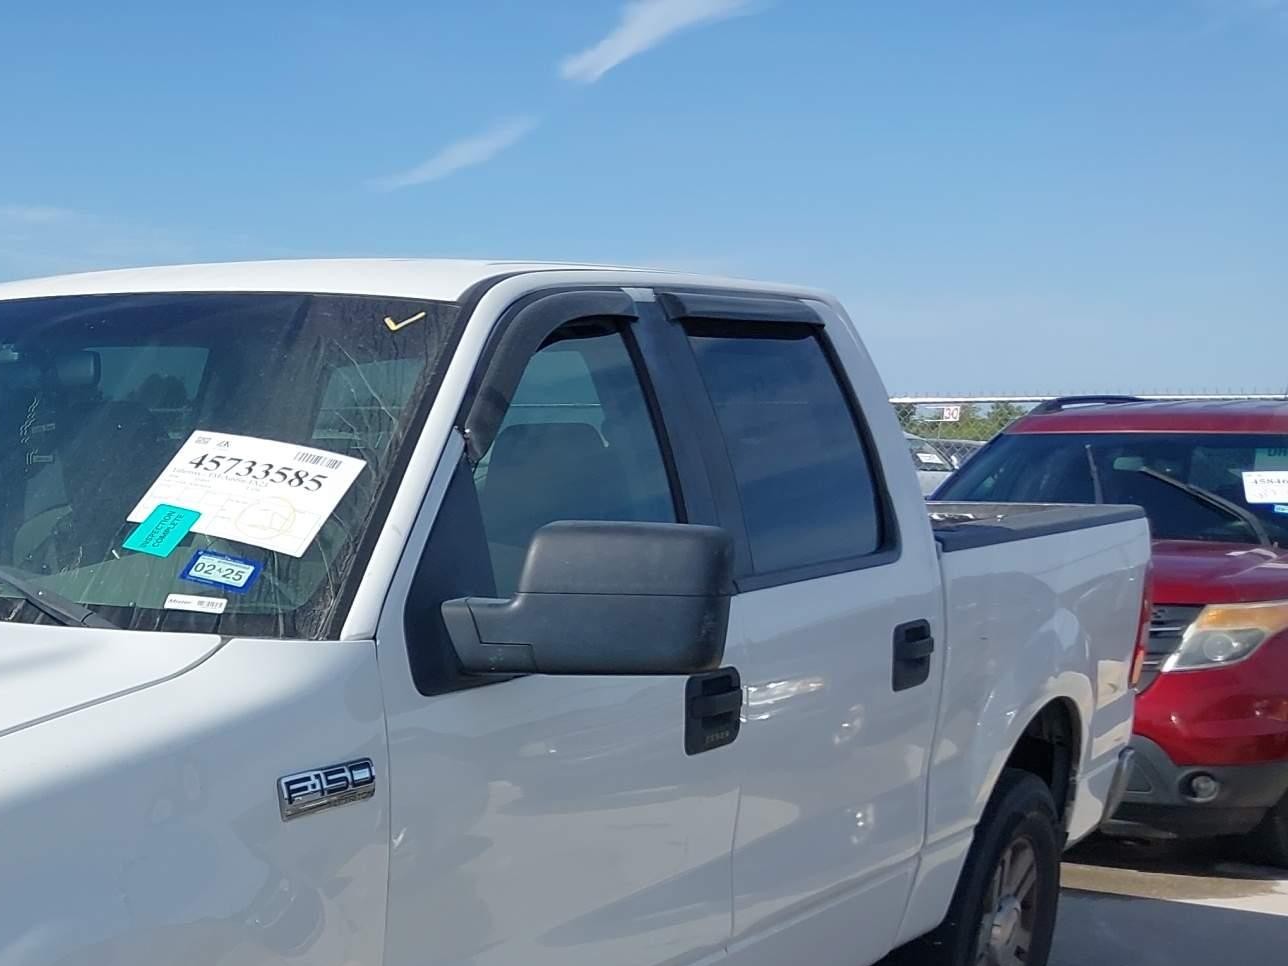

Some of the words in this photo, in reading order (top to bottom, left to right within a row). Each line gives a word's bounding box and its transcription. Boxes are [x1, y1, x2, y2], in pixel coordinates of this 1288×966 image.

[189, 453, 329, 492] 45733585
[140, 510, 176, 547] INSPECTION
[152, 513, 184, 548] COMPLETE
